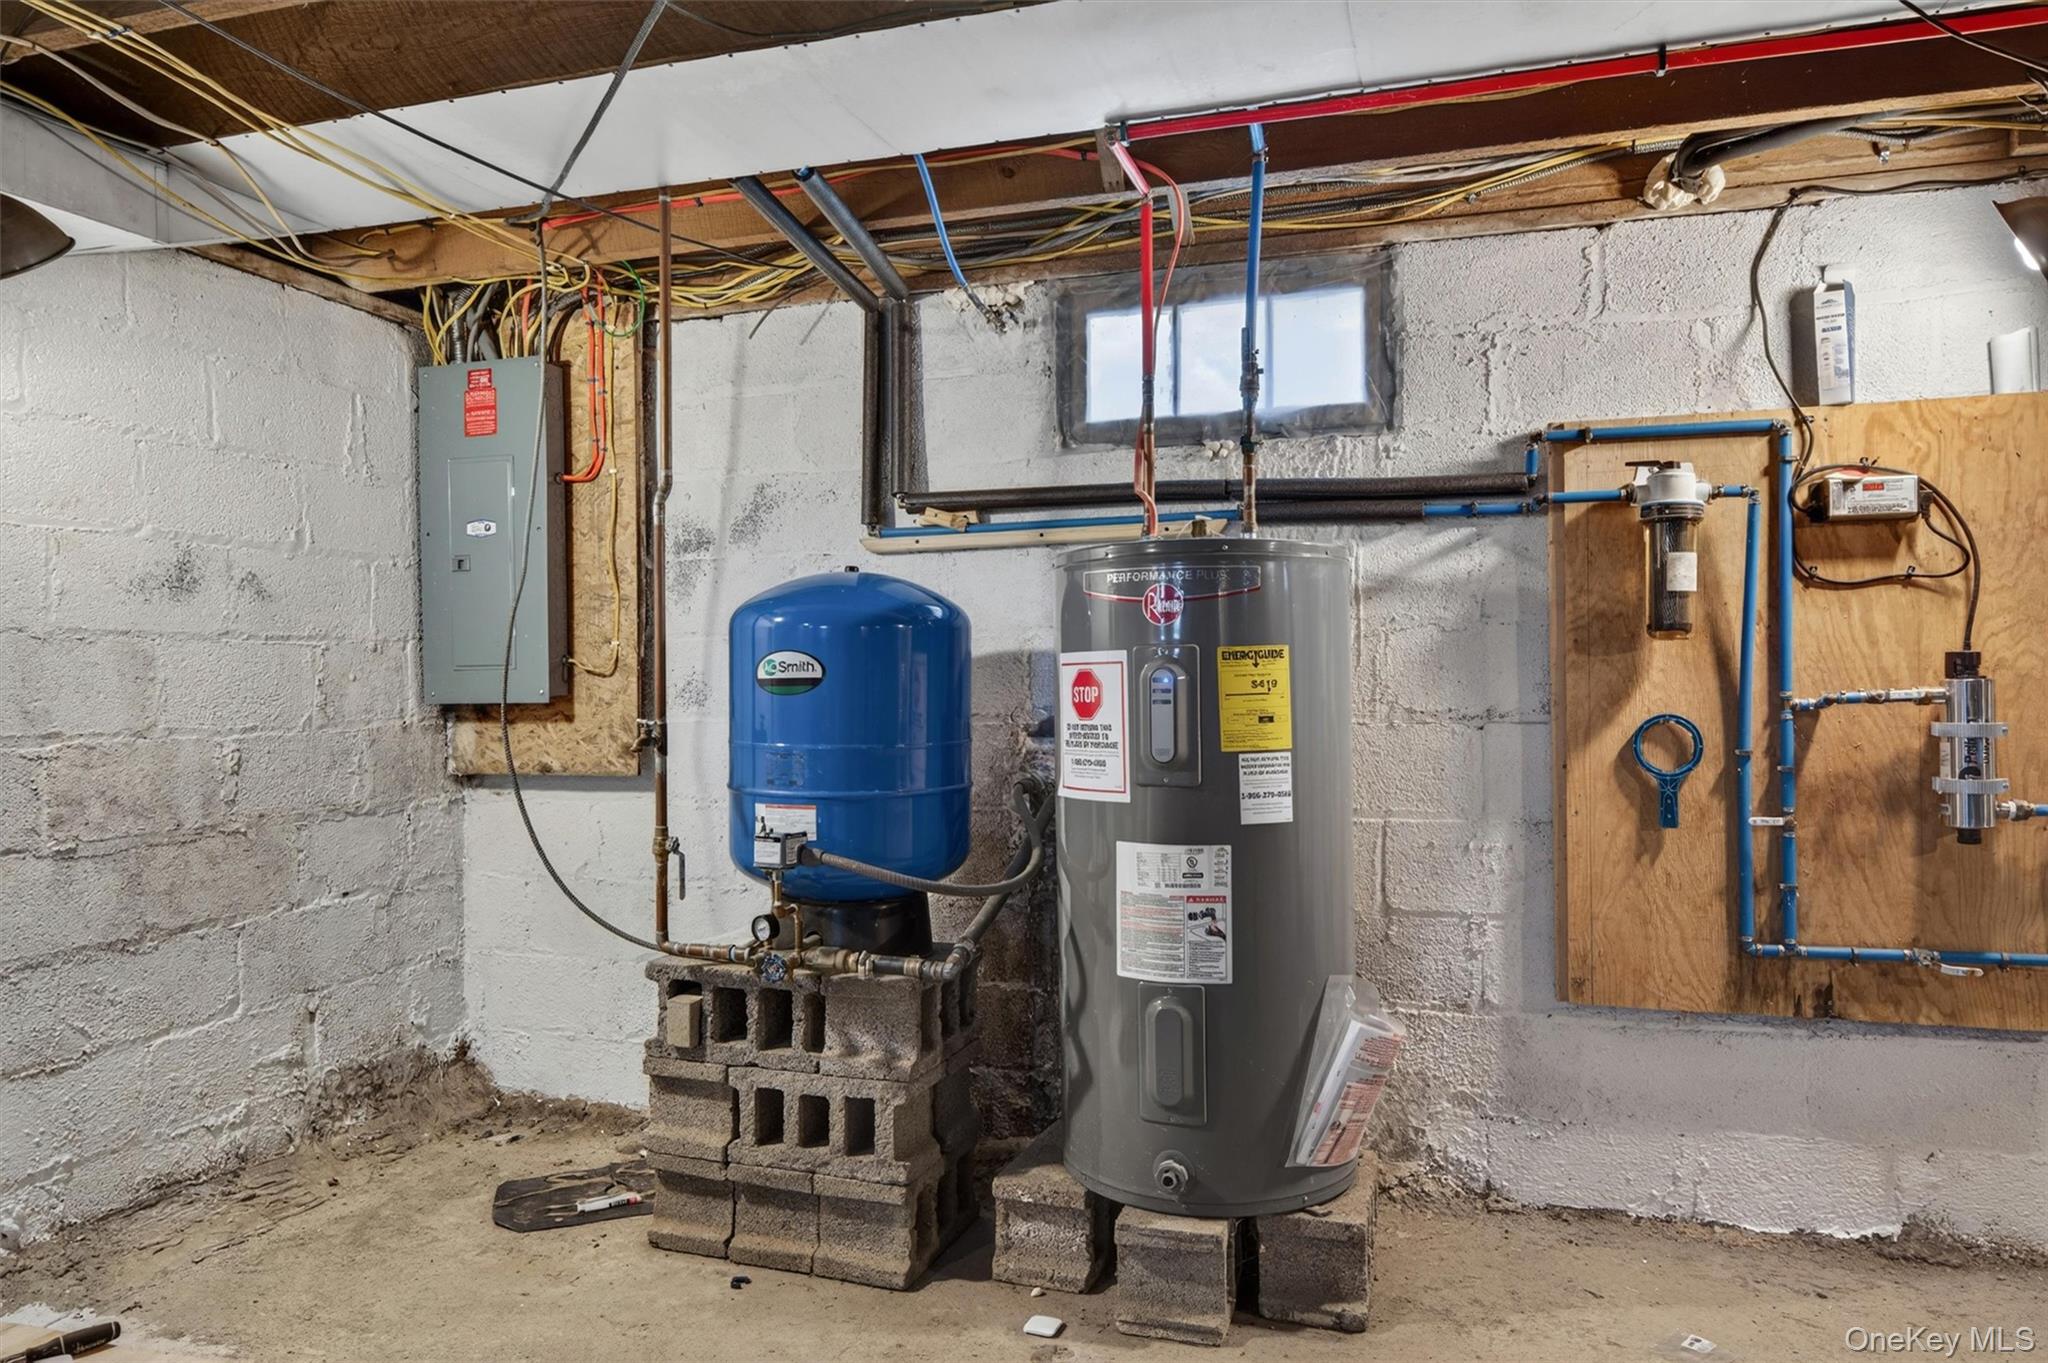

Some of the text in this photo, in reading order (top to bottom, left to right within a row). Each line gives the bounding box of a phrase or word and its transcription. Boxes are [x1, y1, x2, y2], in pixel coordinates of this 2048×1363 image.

[1106, 569, 1193, 584] PERFORMANCE
[778, 660, 816, 673] Smith
[1073, 686, 1100, 703] STOP
